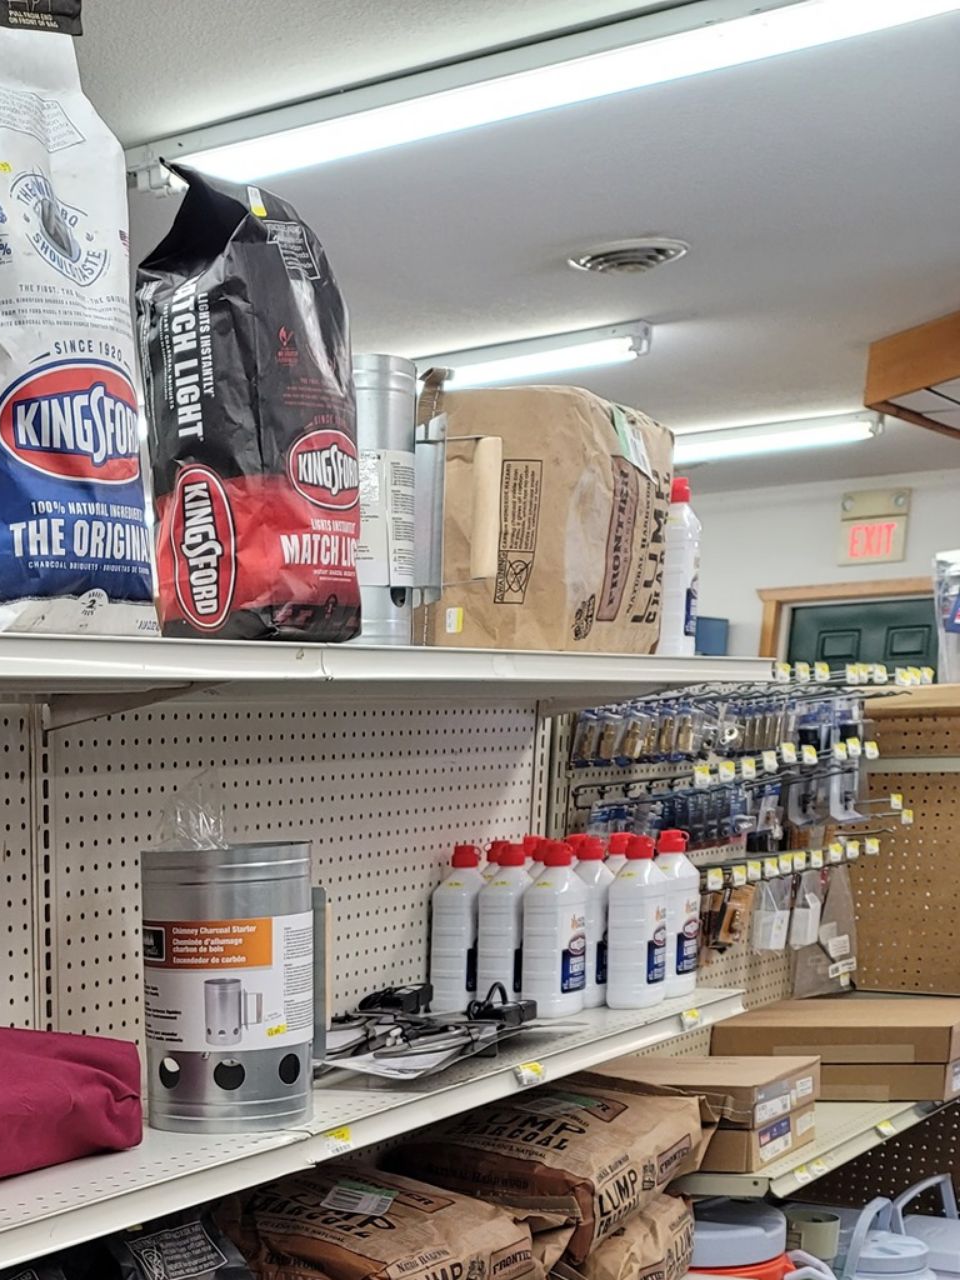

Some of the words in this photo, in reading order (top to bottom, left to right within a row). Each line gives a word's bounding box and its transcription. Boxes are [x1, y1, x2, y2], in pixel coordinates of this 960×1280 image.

[197, 293, 211, 335] LIGHTS
[54, 340, 94, 355] SINCE
[99, 342, 122, 361] 1920
[199, 336, 215, 397] INSTANTLY
[172, 358, 204, 440] LIGHT
[9, 517, 67, 558] THE
[73, 519, 151, 562] ORIGINA
[181, 483, 224, 616] KINGSFORD
[280, 534, 339, 565] MATCH
[342, 538, 357, 567] LIG
[848, 522, 897, 559] EXIT
[172, 927, 198, 936] Chimney
[200, 926, 231, 935] Charcoal
[232, 925, 257, 934] Starter
[597, 1169, 639, 1217] LUMP
